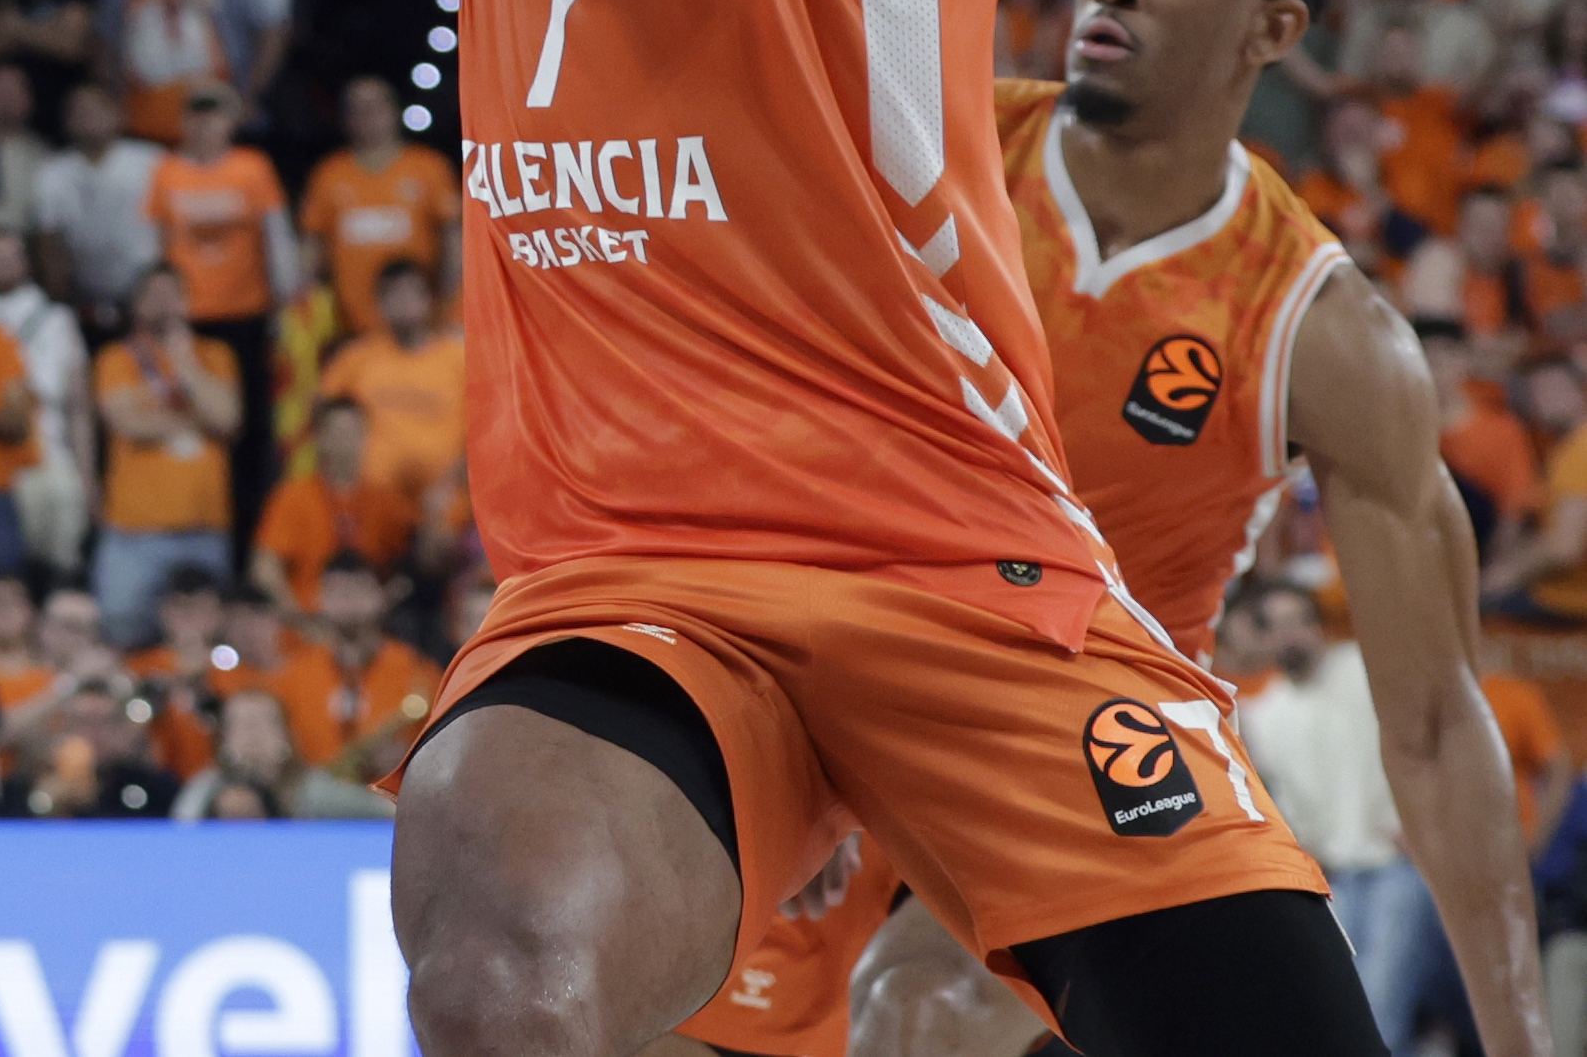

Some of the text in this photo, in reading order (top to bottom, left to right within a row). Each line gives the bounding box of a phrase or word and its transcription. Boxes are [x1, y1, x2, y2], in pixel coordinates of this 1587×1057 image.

[508, 225, 650, 270] BASKET
[1157, 699, 1265, 822] 7
[1114, 791, 1197, 825] EuroLeague
